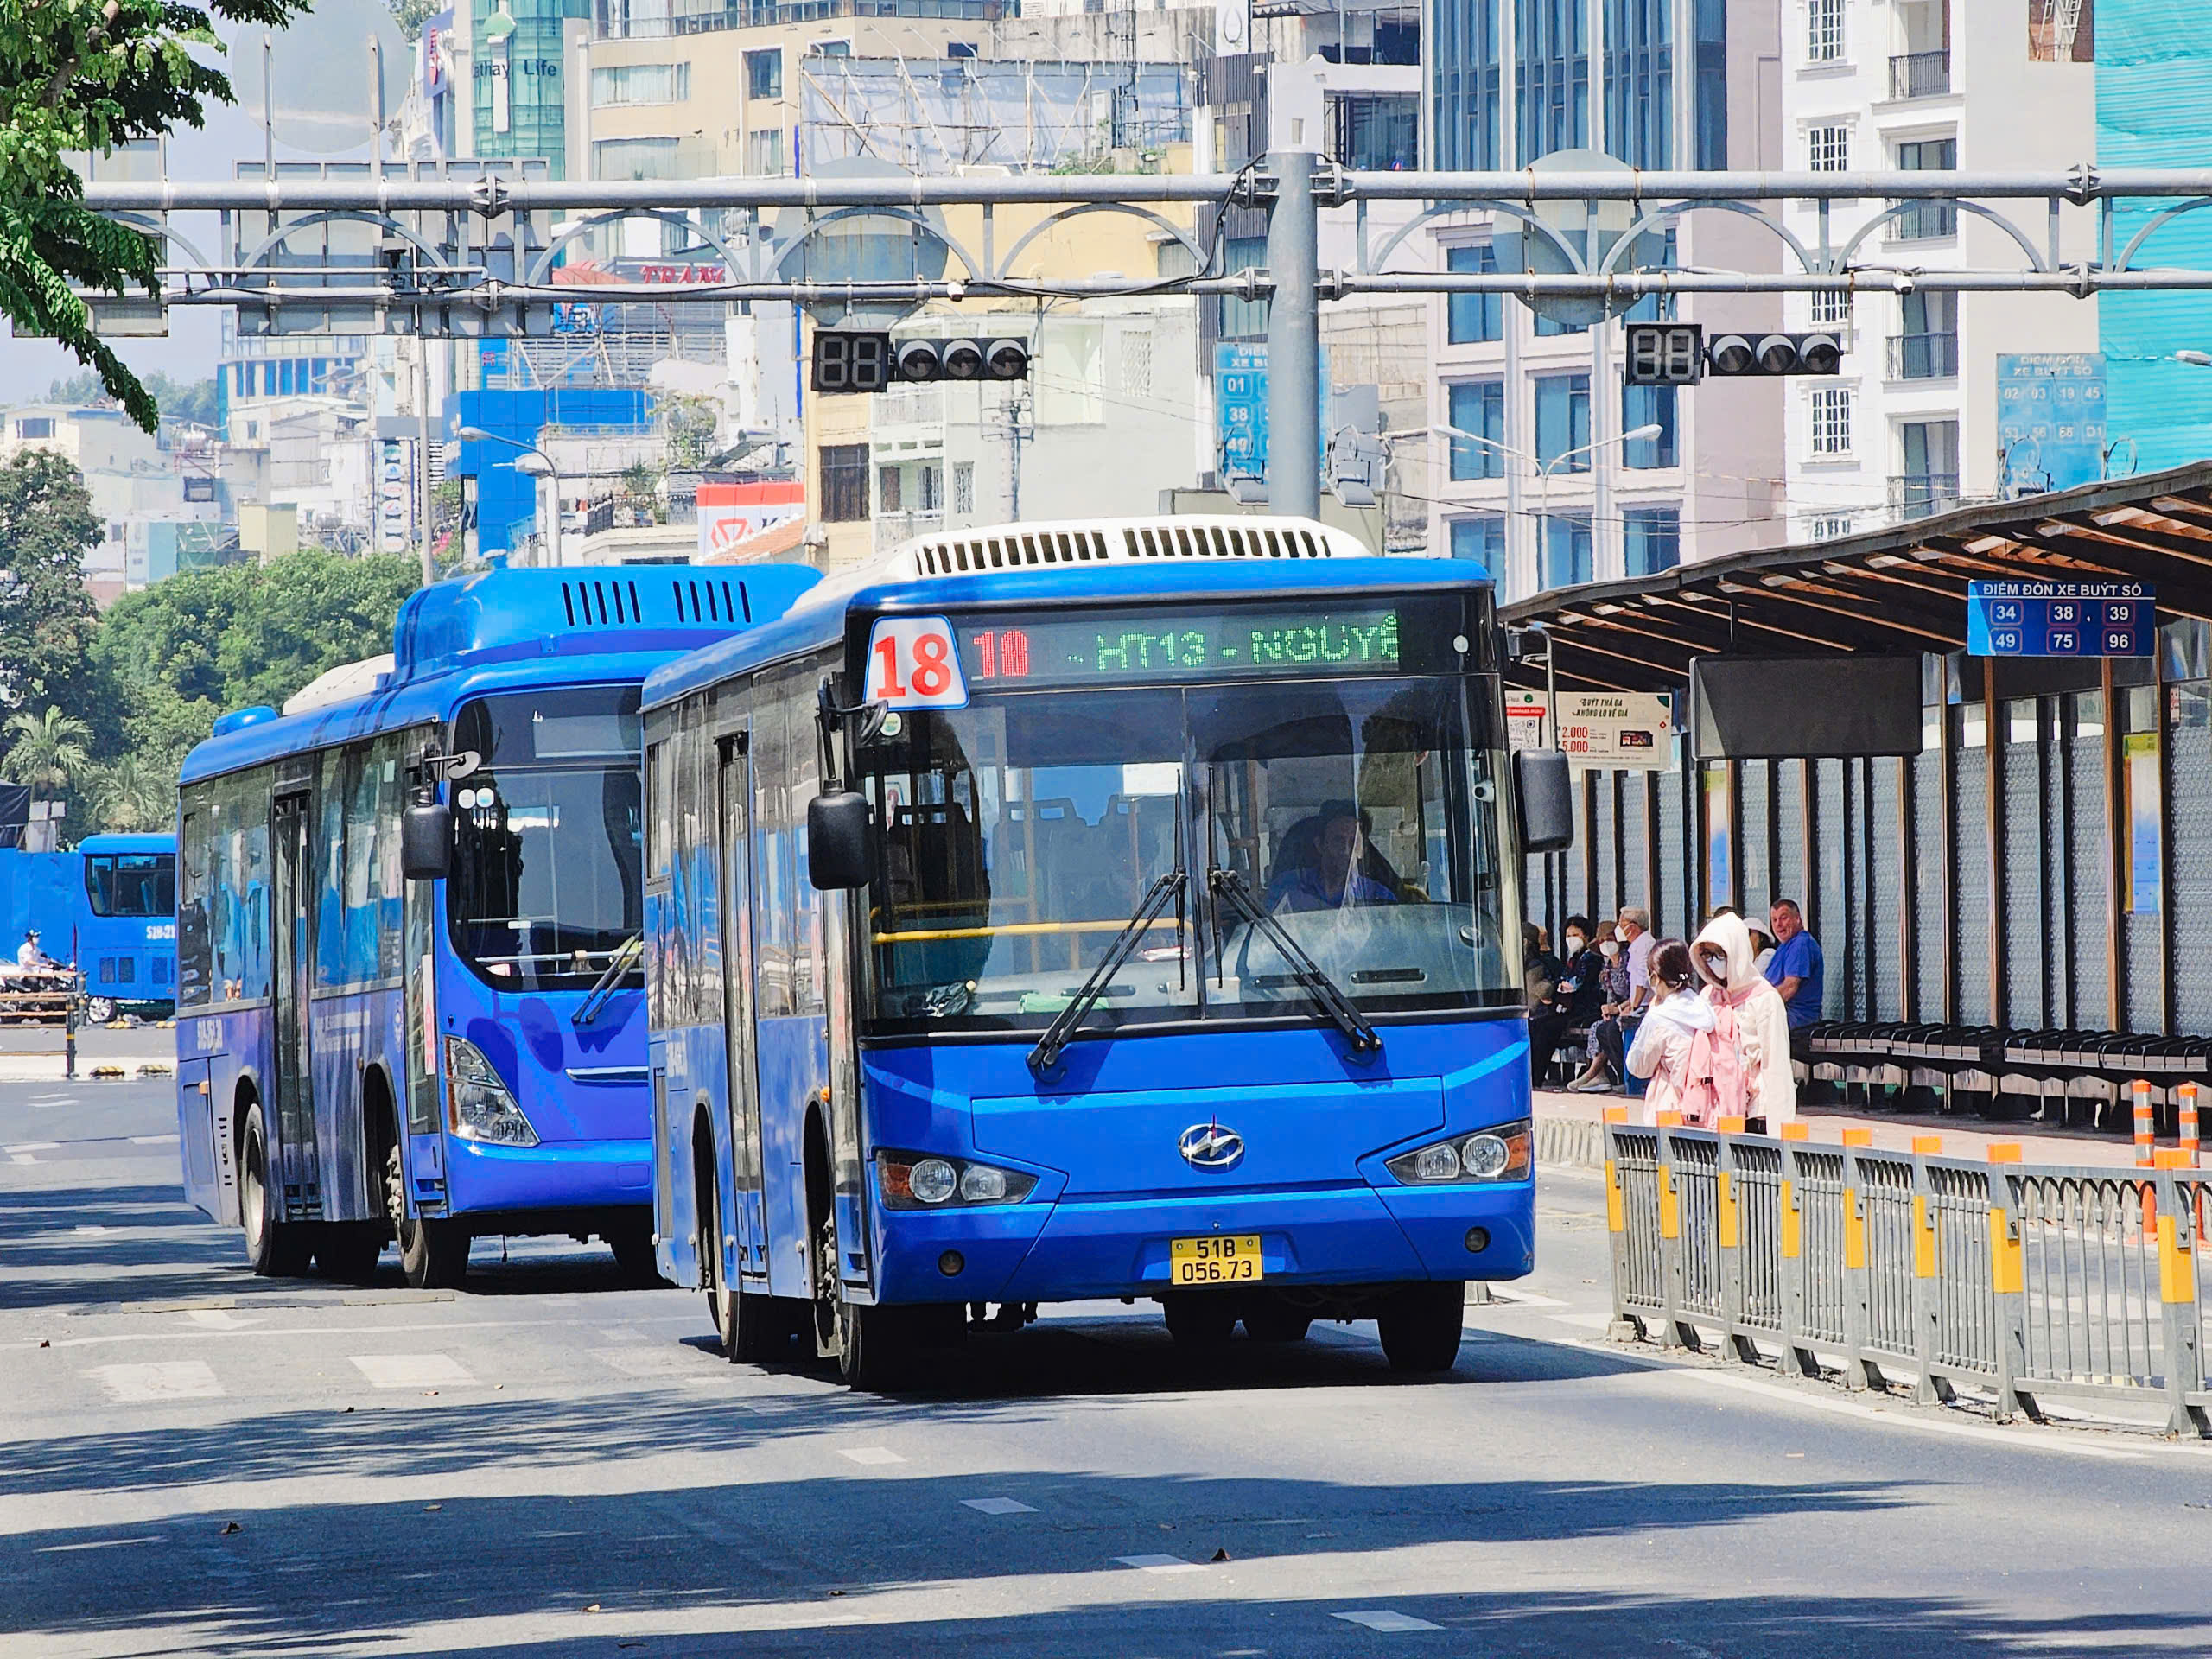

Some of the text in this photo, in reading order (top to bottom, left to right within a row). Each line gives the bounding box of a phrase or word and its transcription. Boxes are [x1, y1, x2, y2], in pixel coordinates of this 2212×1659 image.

[472, 59, 557, 79] athay Life
[1231, 358, 1249, 367] XE
[1227, 377, 1245, 392] 01
[2004, 388, 2018, 399] 02
[2031, 388, 2046, 399] 03
[2085, 387, 2100, 398] 45
[1229, 407, 1248, 422] 38
[1227, 437, 1247, 453] 49
[1982, 582, 2143, 596] ĐIỂM ĐÓN XE BUÝT SỐ
[1995, 606, 2129, 620] 34 38 39
[1995, 633, 2129, 648] 49 75 96
[973, 630, 1029, 677] 18
[1097, 630, 1205, 671] HT13
[874, 632, 952, 698] 18
[1561, 726, 1588, 739] 2.000
[1561, 741, 1588, 753] 5.000
[1196, 1238, 1236, 1259] 51B
[1181, 1260, 1253, 1282] 056.73
